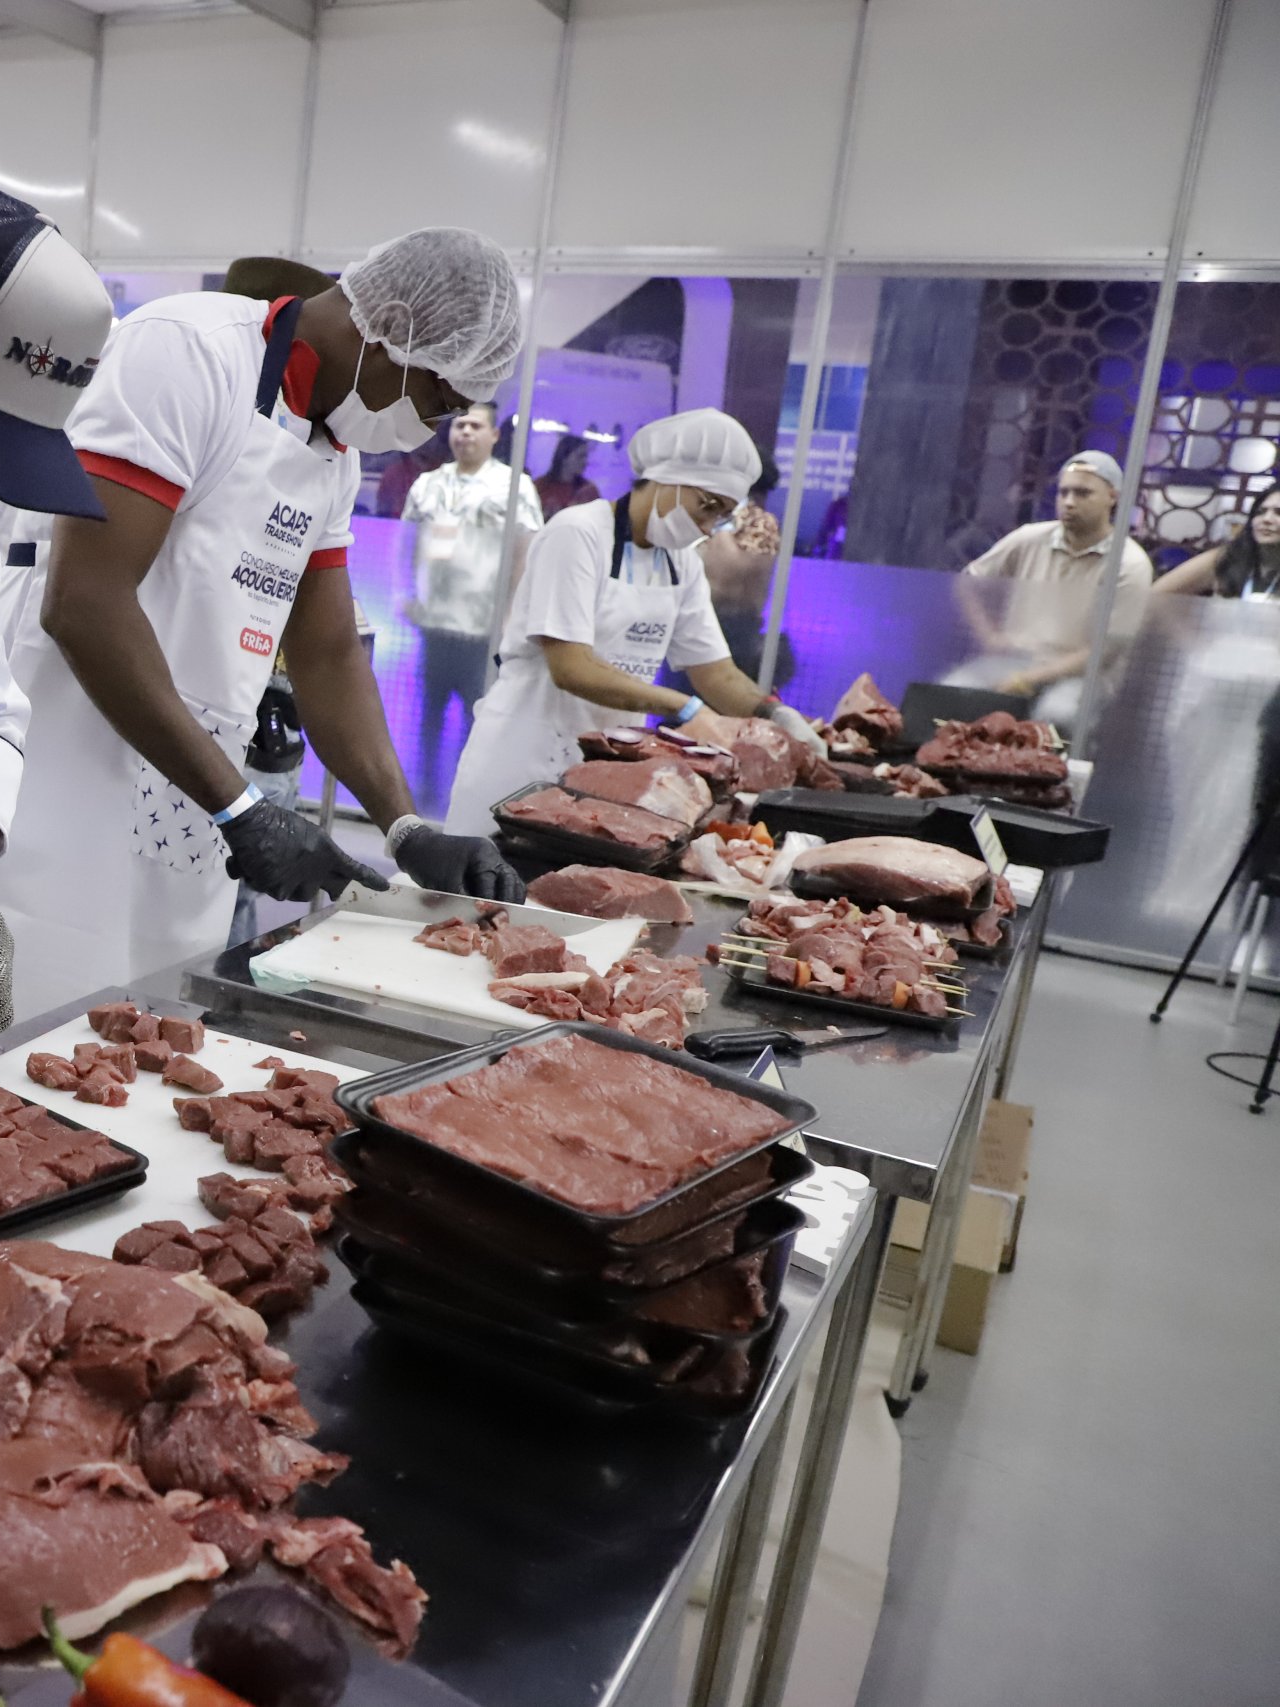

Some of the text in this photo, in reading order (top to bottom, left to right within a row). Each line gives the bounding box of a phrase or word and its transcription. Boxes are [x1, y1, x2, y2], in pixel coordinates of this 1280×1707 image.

[268, 501, 312, 536] ACAPS
[264, 523, 304, 548] TRADE SHOW
[240, 551, 280, 577] CONCURSO
[231, 564, 296, 603] AÇOUGUEIRO
[626, 622, 667, 637] ACAPS
